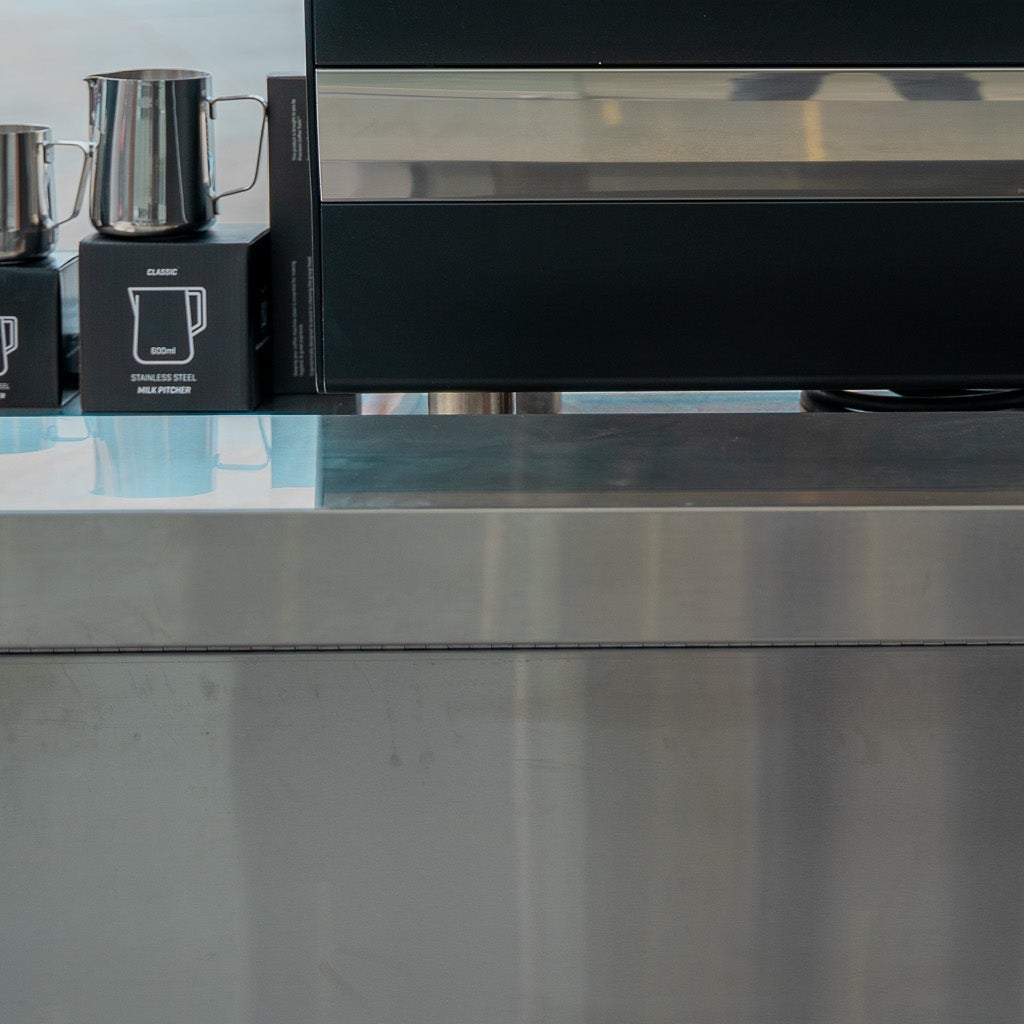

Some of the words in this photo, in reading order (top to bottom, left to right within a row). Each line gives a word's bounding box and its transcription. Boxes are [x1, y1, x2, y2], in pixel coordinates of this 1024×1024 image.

[146, 268, 178, 276] CLASSIC
[150, 347, 176, 355] 600ml
[130, 374, 172, 382] STAINLESS
[173, 374, 197, 382] STEEL
[137, 386, 157, 394] MILK
[158, 386, 192, 394] PITCHER
